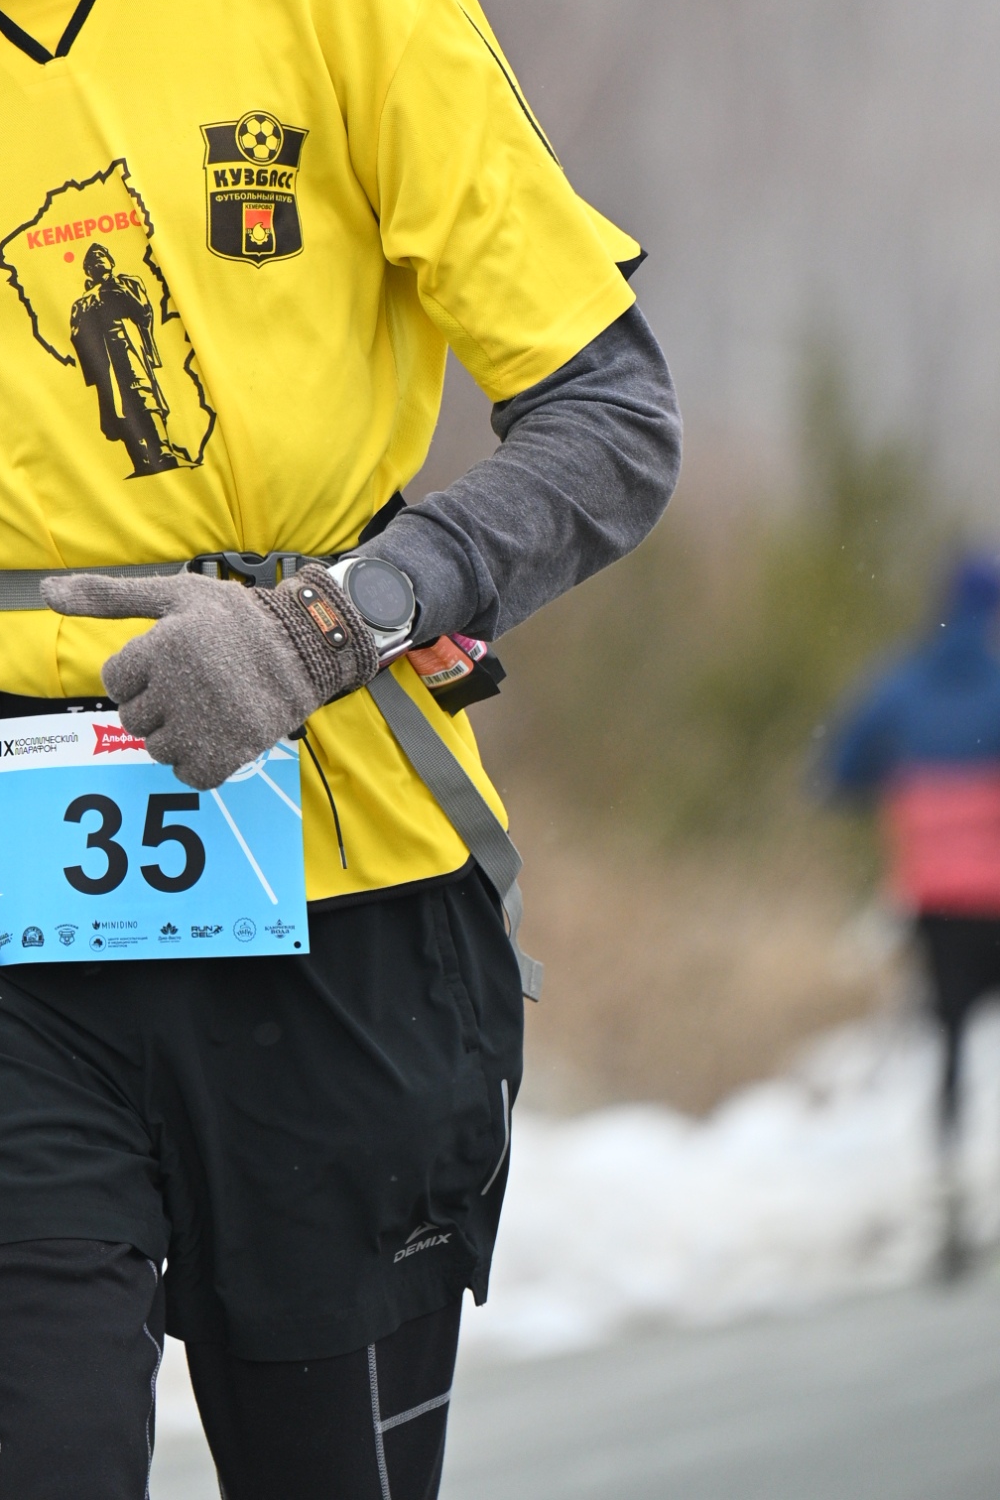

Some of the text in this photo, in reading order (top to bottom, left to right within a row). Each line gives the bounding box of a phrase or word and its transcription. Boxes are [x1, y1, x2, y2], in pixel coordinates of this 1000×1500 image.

[213, 168, 294, 190] КУЗБАСС
[215, 192, 293, 204] ФУТБОЛЬНЫЙ КЛУБ
[15, 732, 79, 747] КОСМИЧЕСКИЙ
[101, 733, 133, 743] Альфа
[14, 744, 57, 756] МАРАФОН
[62, 792, 206, 896] 35
[101, 920, 138, 929] MINIDINO
[393, 1233, 452, 1264] DEMIX
